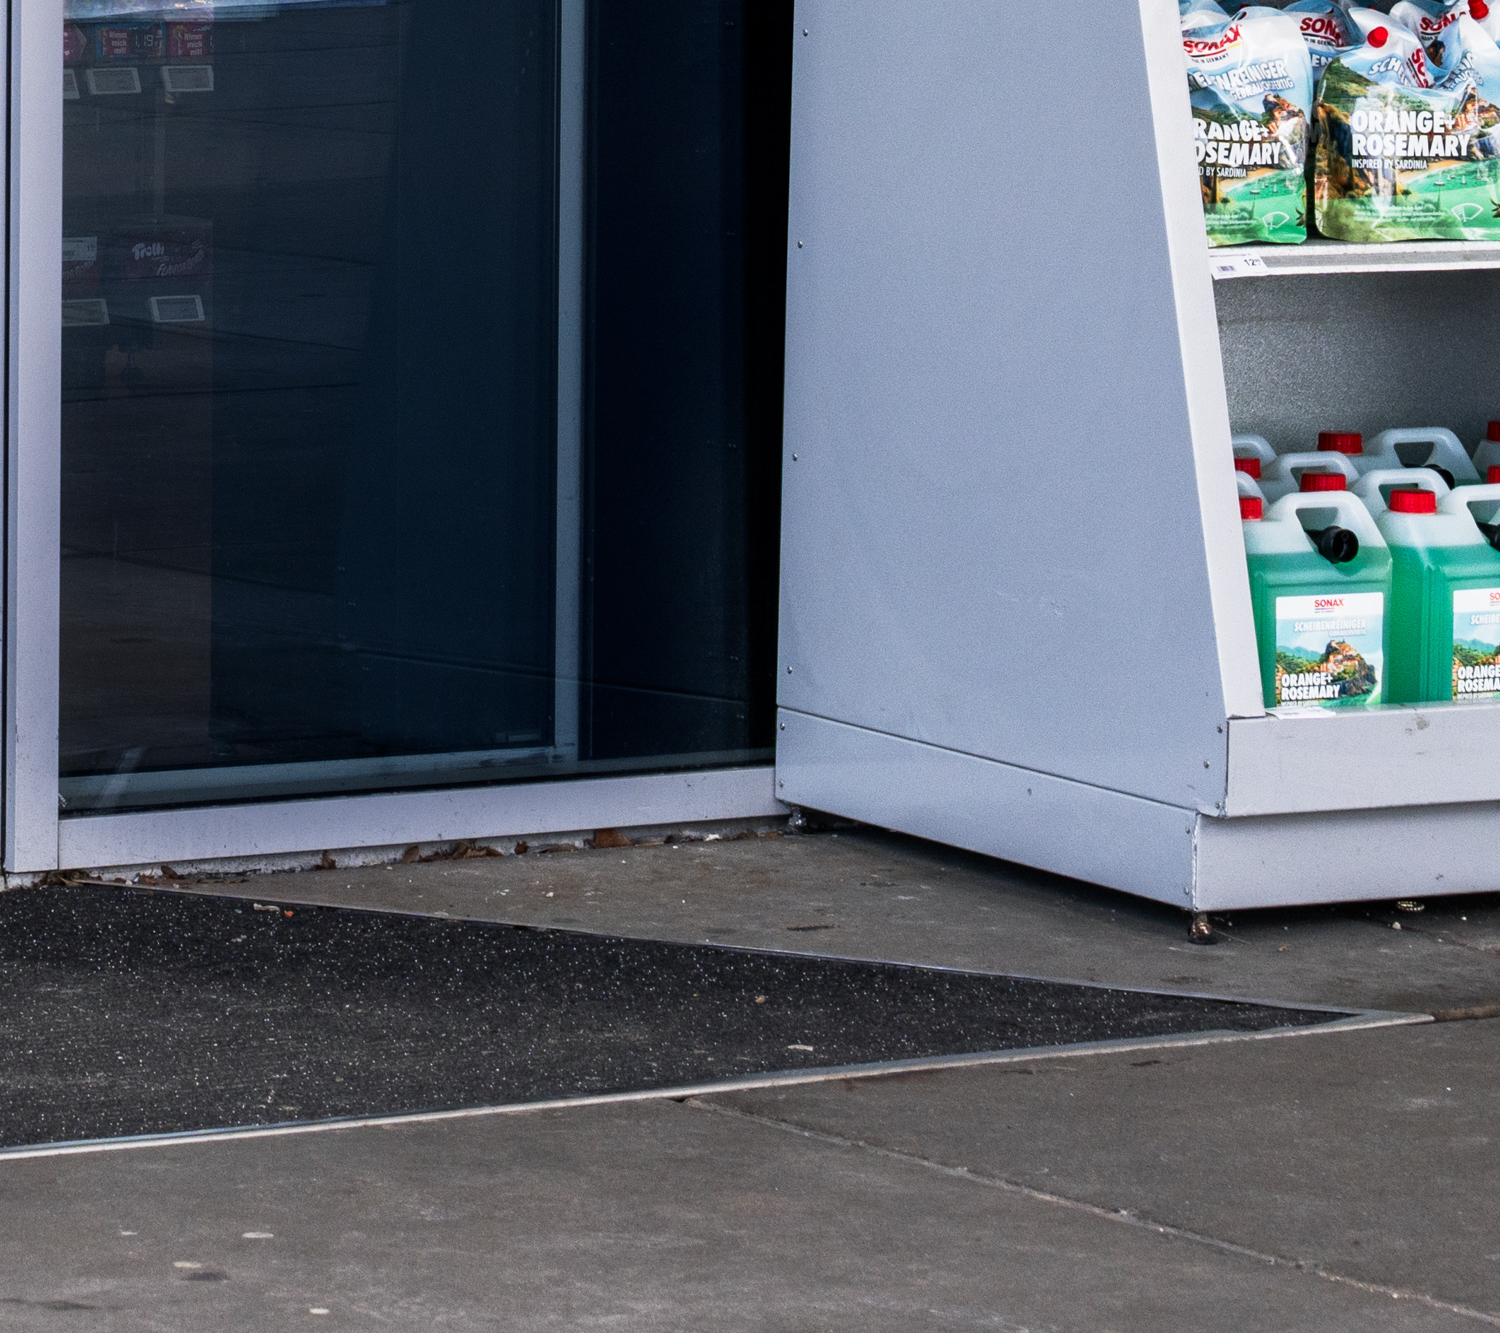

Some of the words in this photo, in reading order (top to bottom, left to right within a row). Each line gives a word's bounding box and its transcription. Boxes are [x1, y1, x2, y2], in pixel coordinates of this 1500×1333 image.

[1351, 109, 1456, 136] ORANGE+
[1351, 133, 1471, 158] ROSEMARY
[1351, 158, 1383, 170] INSPIRED
[1395, 157, 1428, 169] SARDINIA
[1315, 599, 1344, 608] SONAX
[1281, 673, 1333, 687] ORANGE+
[1281, 685, 1341, 702] ROSEMARY
